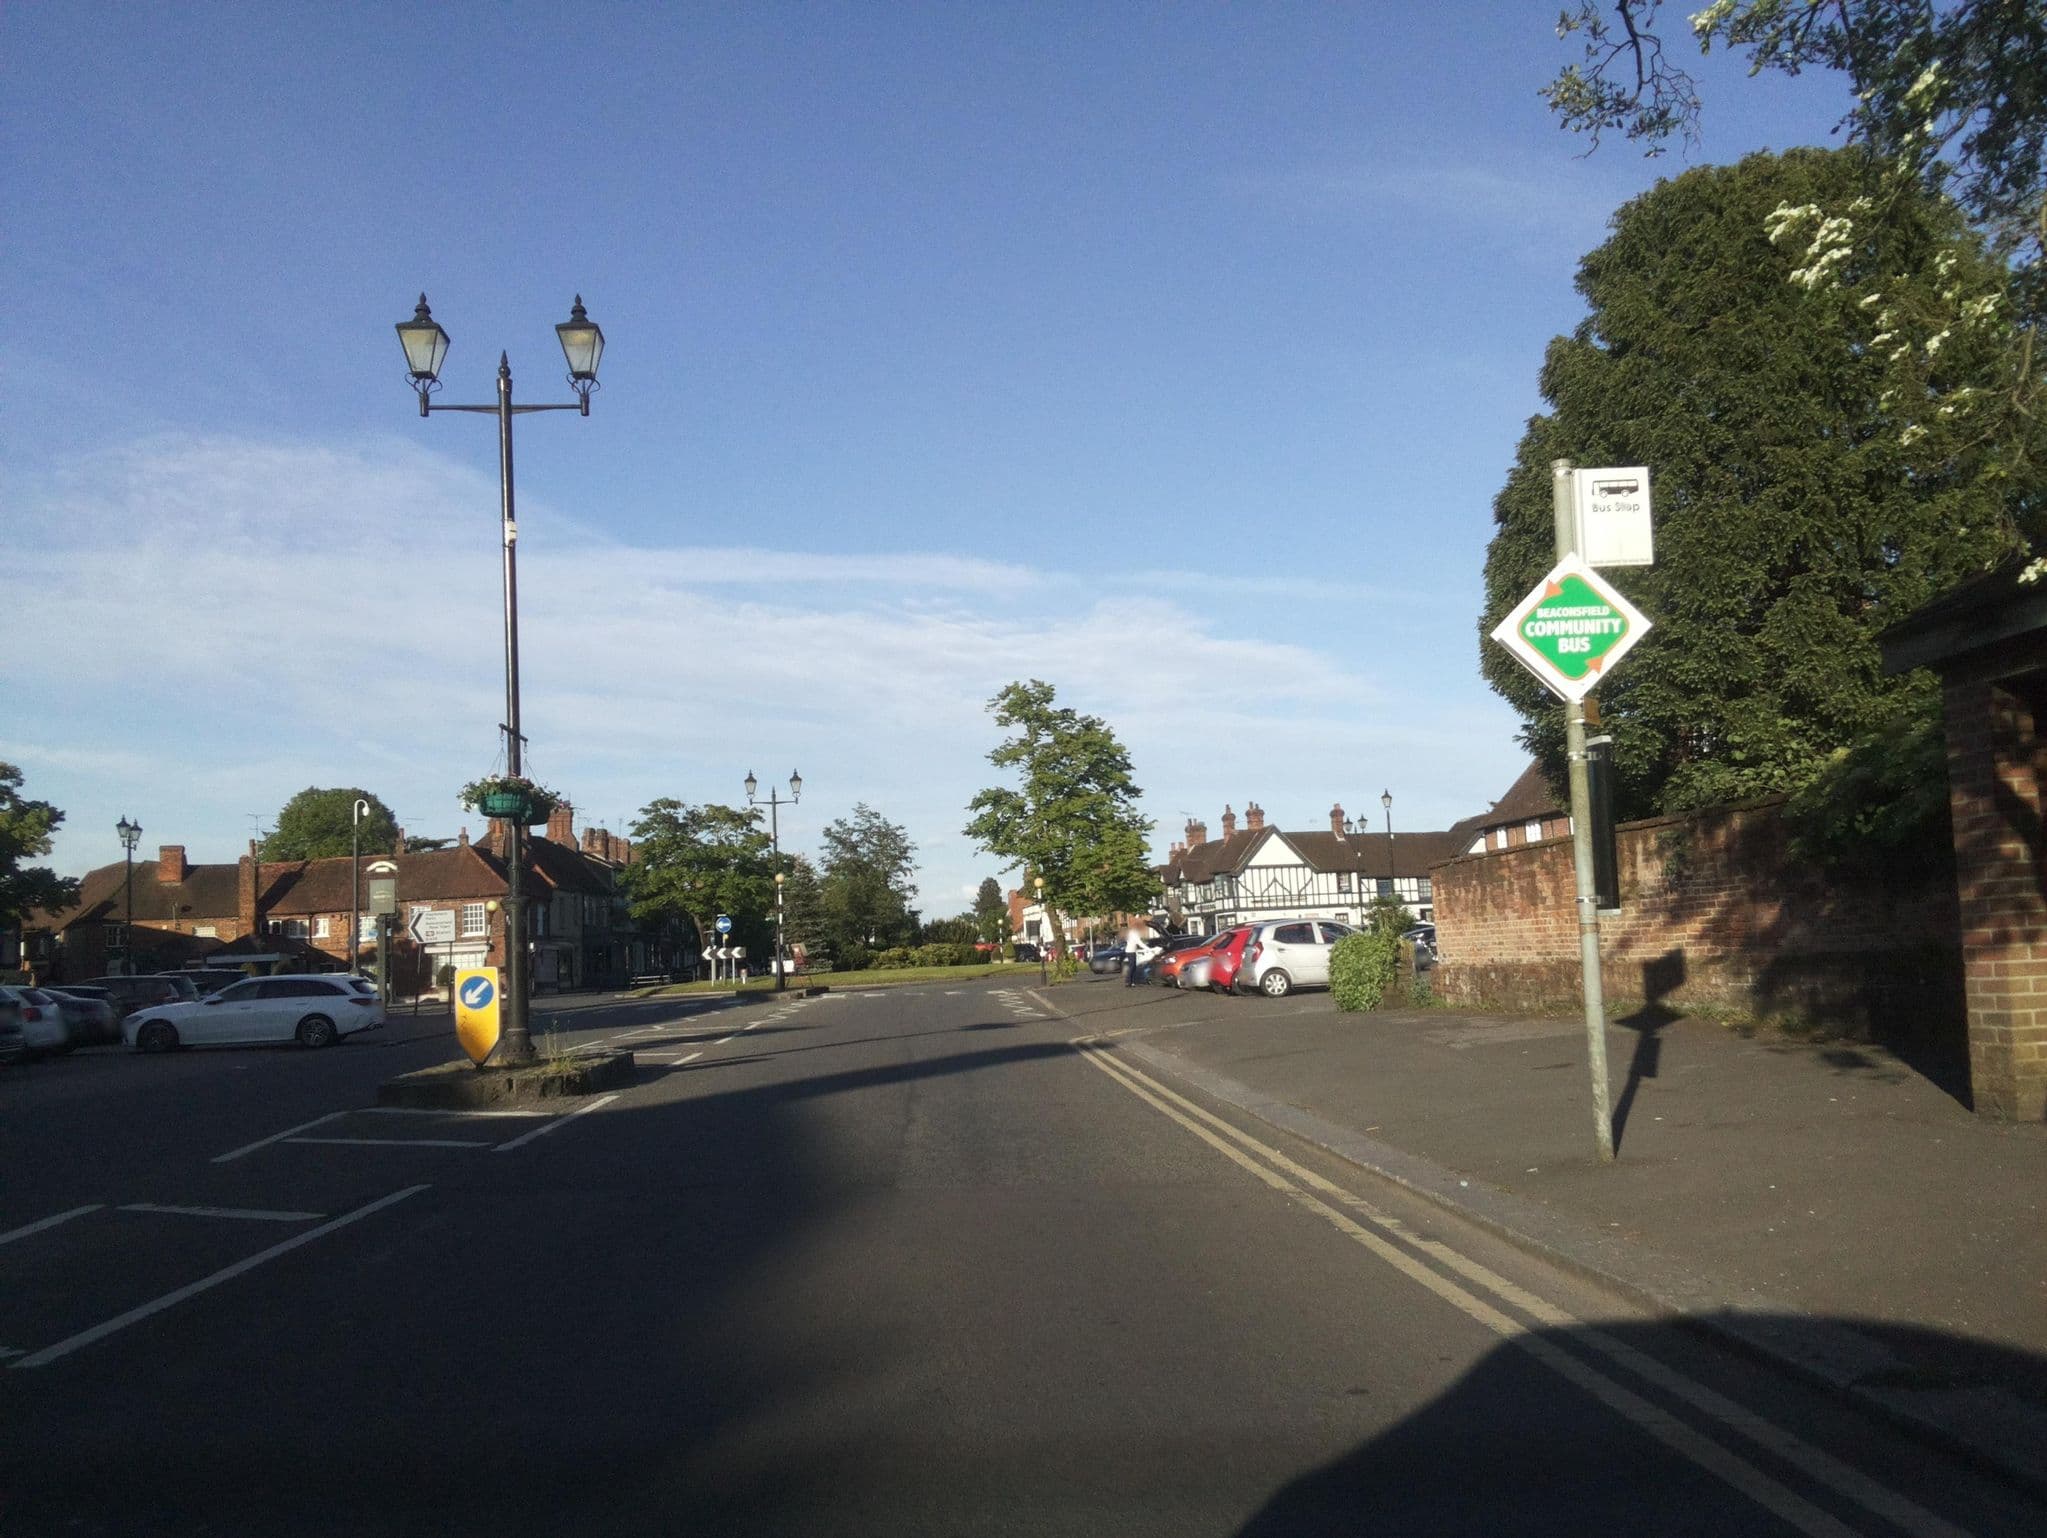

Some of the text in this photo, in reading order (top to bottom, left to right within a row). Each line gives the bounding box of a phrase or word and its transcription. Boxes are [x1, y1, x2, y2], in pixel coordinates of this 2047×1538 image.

[1592, 502, 1640, 513] Bus Stop
[1536, 606, 1609, 618] BEACONSFIELD
[1525, 618, 1622, 637] COMMUNITY
[1558, 637, 1591, 654] BUS
